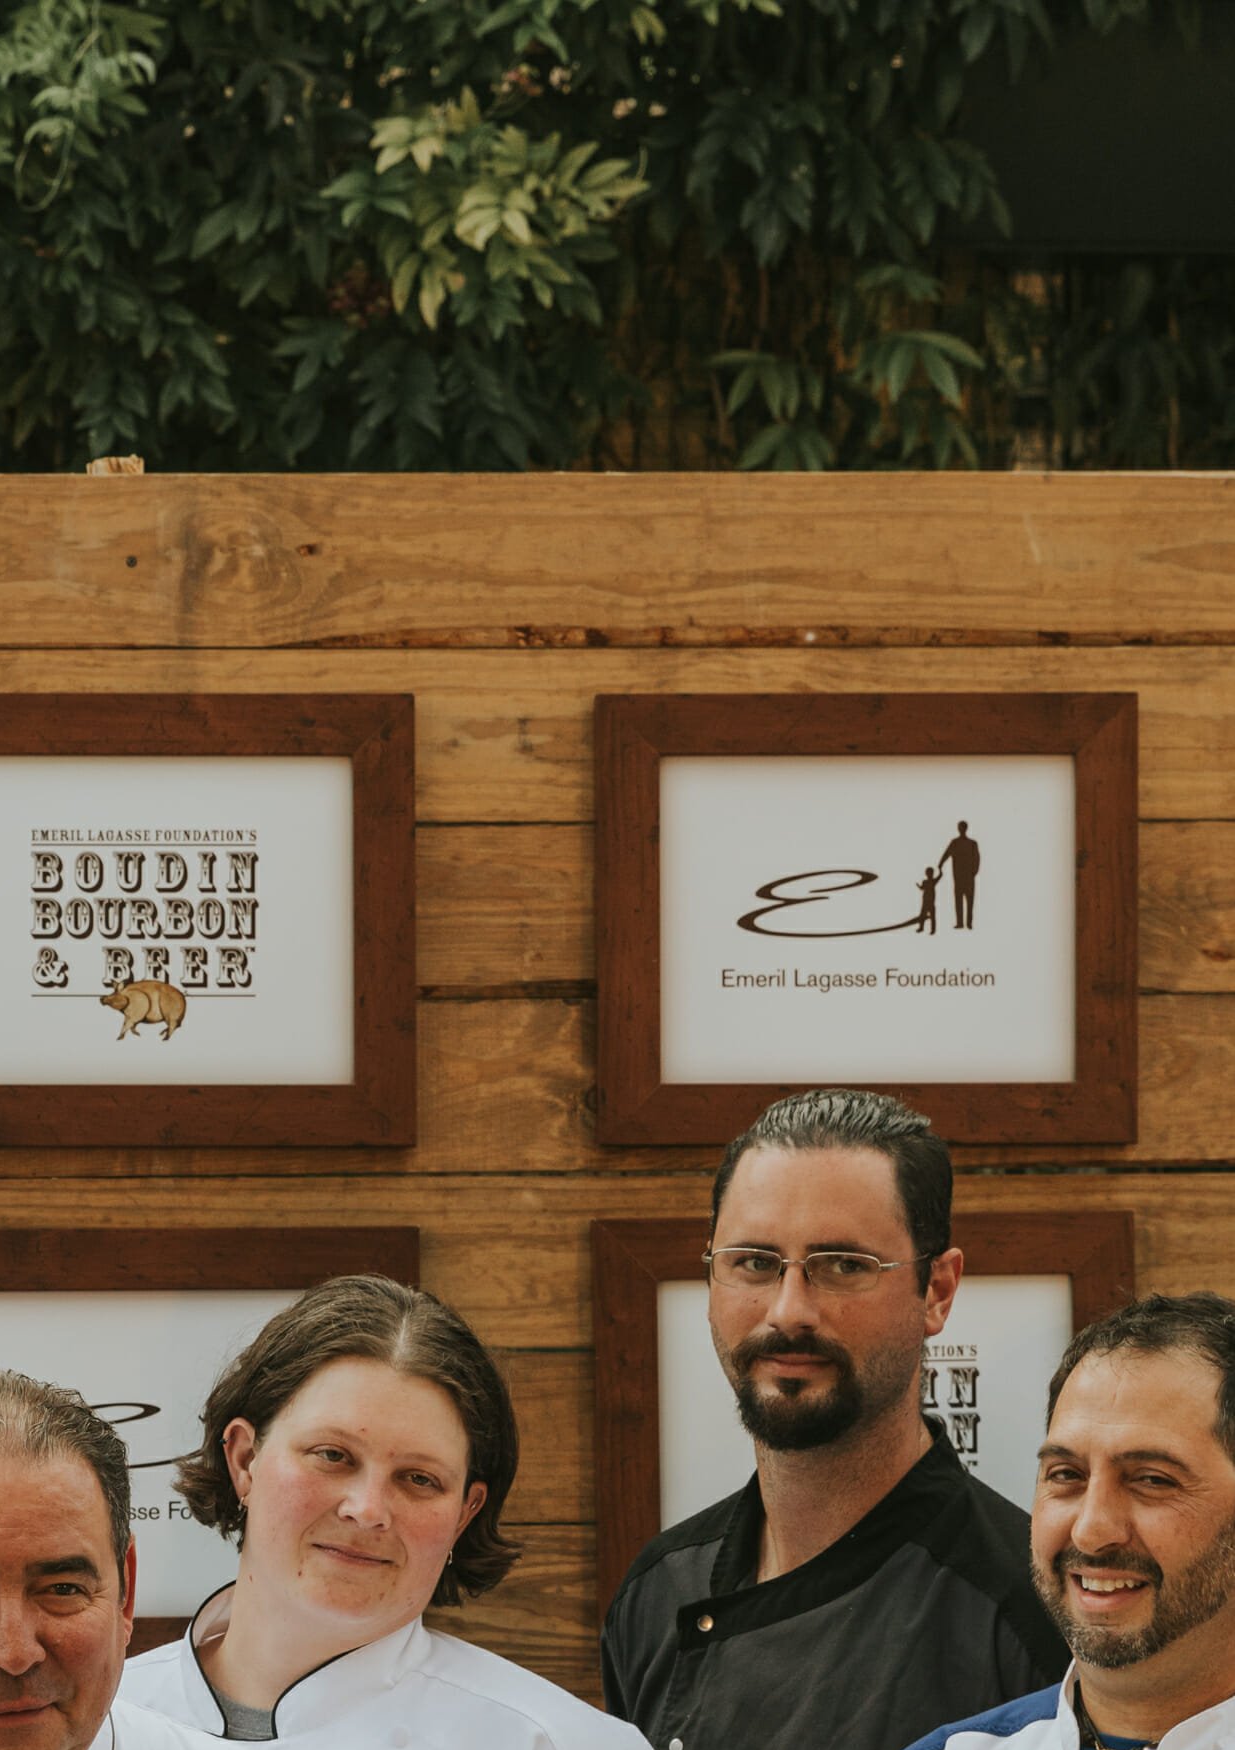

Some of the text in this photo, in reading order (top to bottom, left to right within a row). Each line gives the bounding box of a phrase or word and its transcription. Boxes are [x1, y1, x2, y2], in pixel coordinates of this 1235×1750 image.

[31, 829, 258, 841] EMERIL LAGASSE FOUNDATION'S
[31, 851, 258, 893] BOUDIN
[31, 898, 258, 939] BOURBON
[32, 946, 69, 988] &
[721, 968, 995, 993] Emeril Lagasse Foundation
